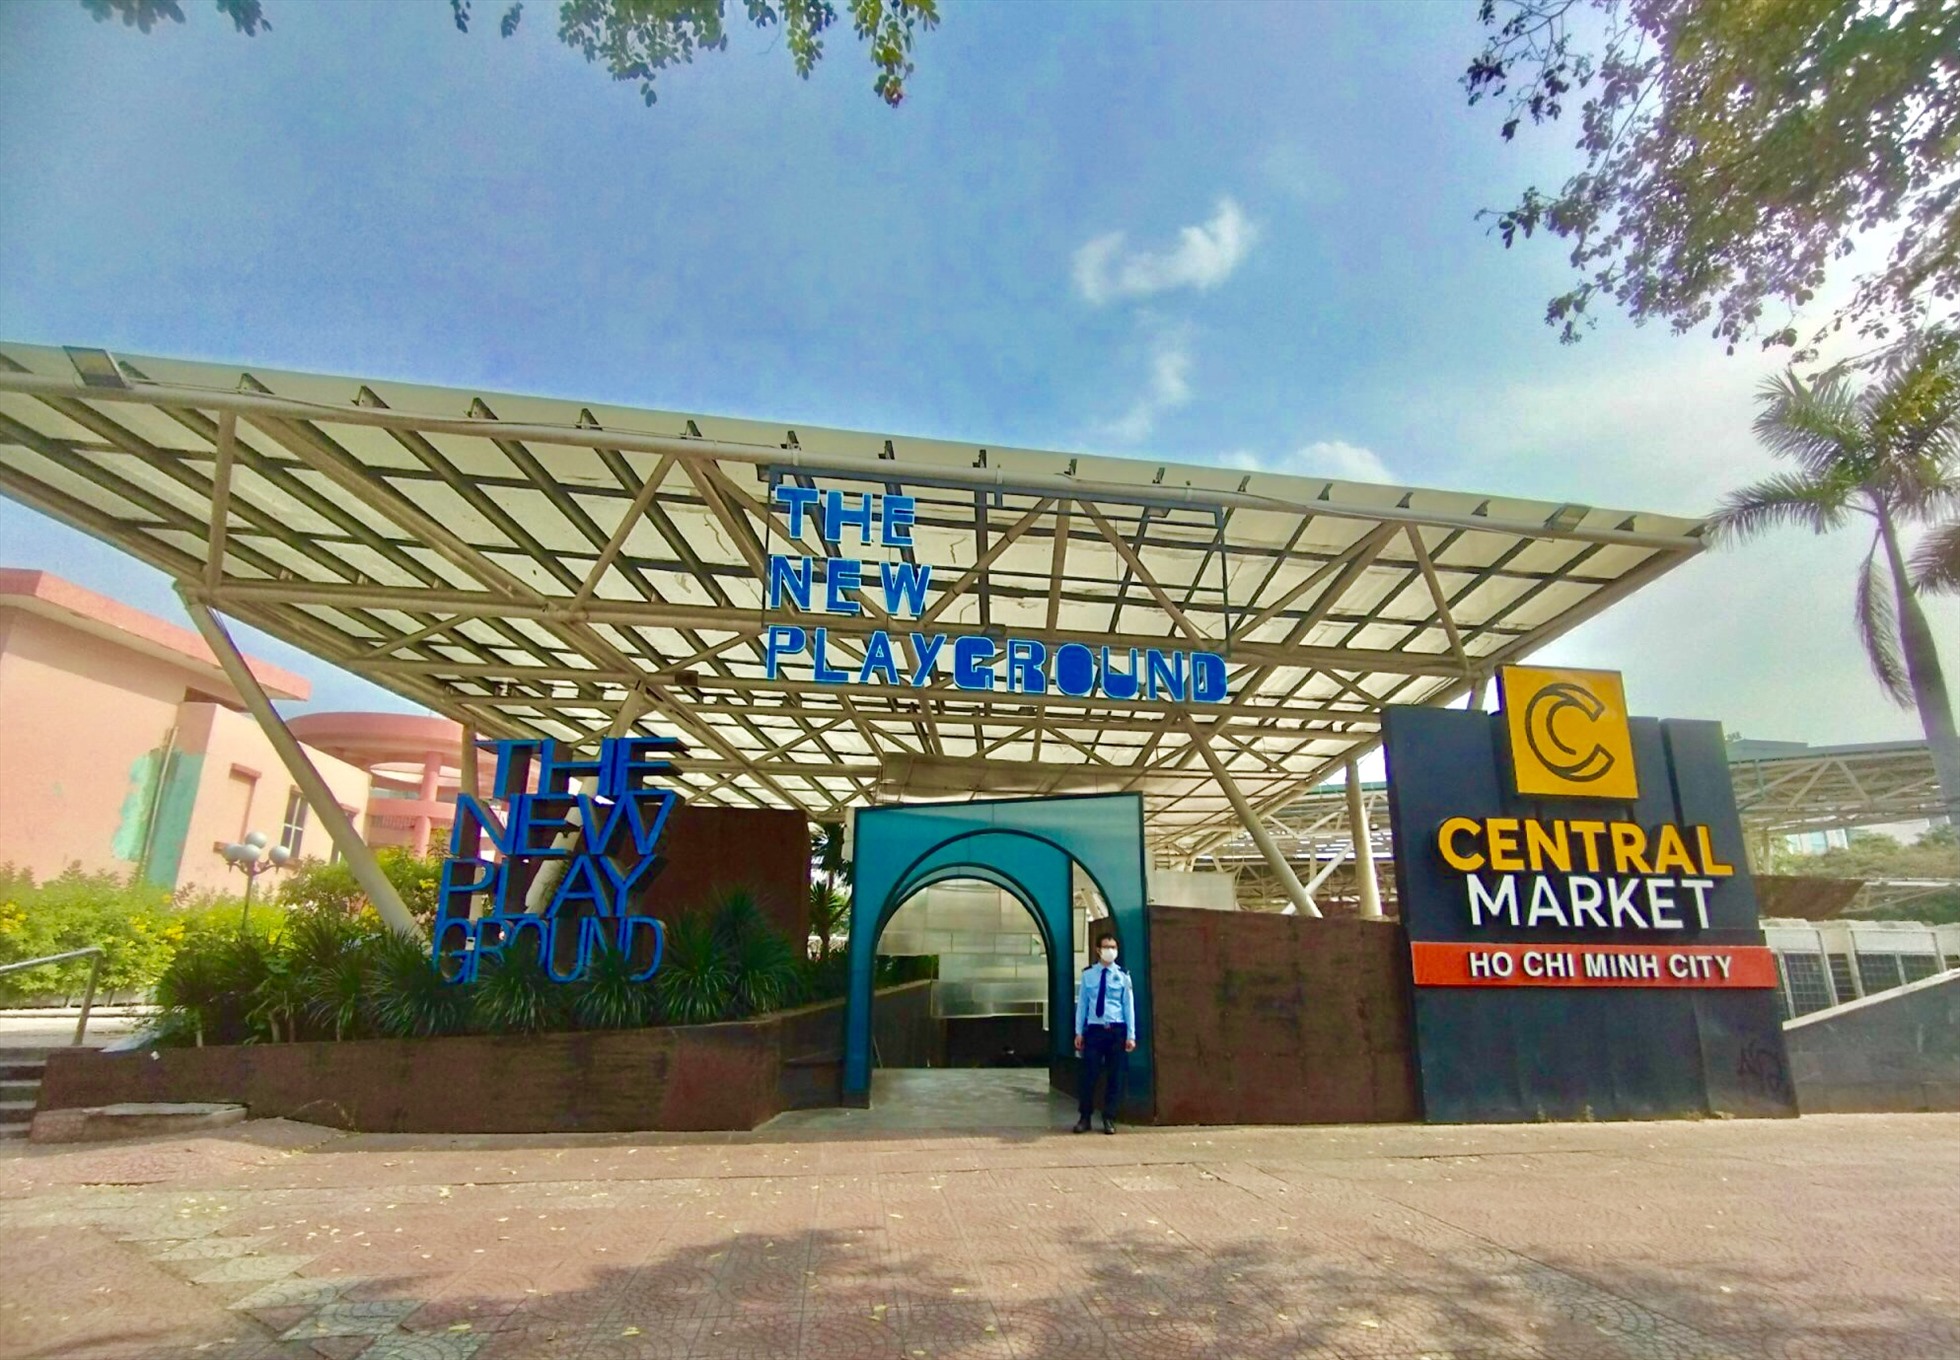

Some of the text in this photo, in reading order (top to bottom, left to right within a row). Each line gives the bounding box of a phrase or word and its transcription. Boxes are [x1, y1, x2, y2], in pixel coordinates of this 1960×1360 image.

[774, 485, 916, 546] THE
[769, 554, 932, 617] NEW
[765, 625, 1228, 703] PLAYGROUND
[473, 736, 690, 798] THE
[450, 792, 686, 856] NEW
[1437, 816, 1734, 876] CENTRAL
[434, 853, 662, 922] PLAY
[1465, 873, 1714, 930] MARKET
[1469, 951, 1733, 980] HO CHI MINH CITY
